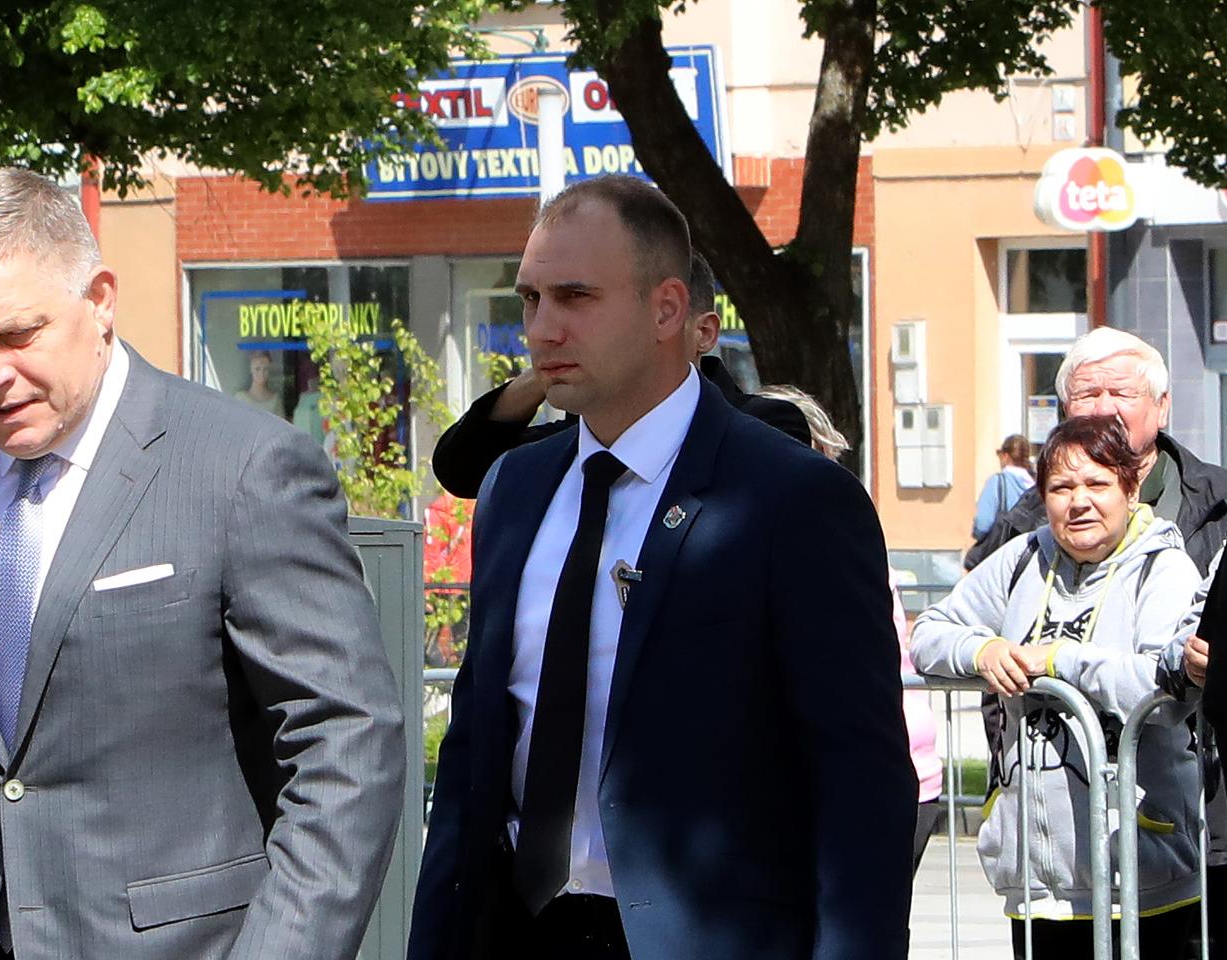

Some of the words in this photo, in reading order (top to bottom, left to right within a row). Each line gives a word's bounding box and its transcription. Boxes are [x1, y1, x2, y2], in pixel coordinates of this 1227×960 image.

[472, 147, 540, 179] TEXTI
[1066, 179, 1128, 212] teta
[239, 298, 302, 337] BYTOVÉ
